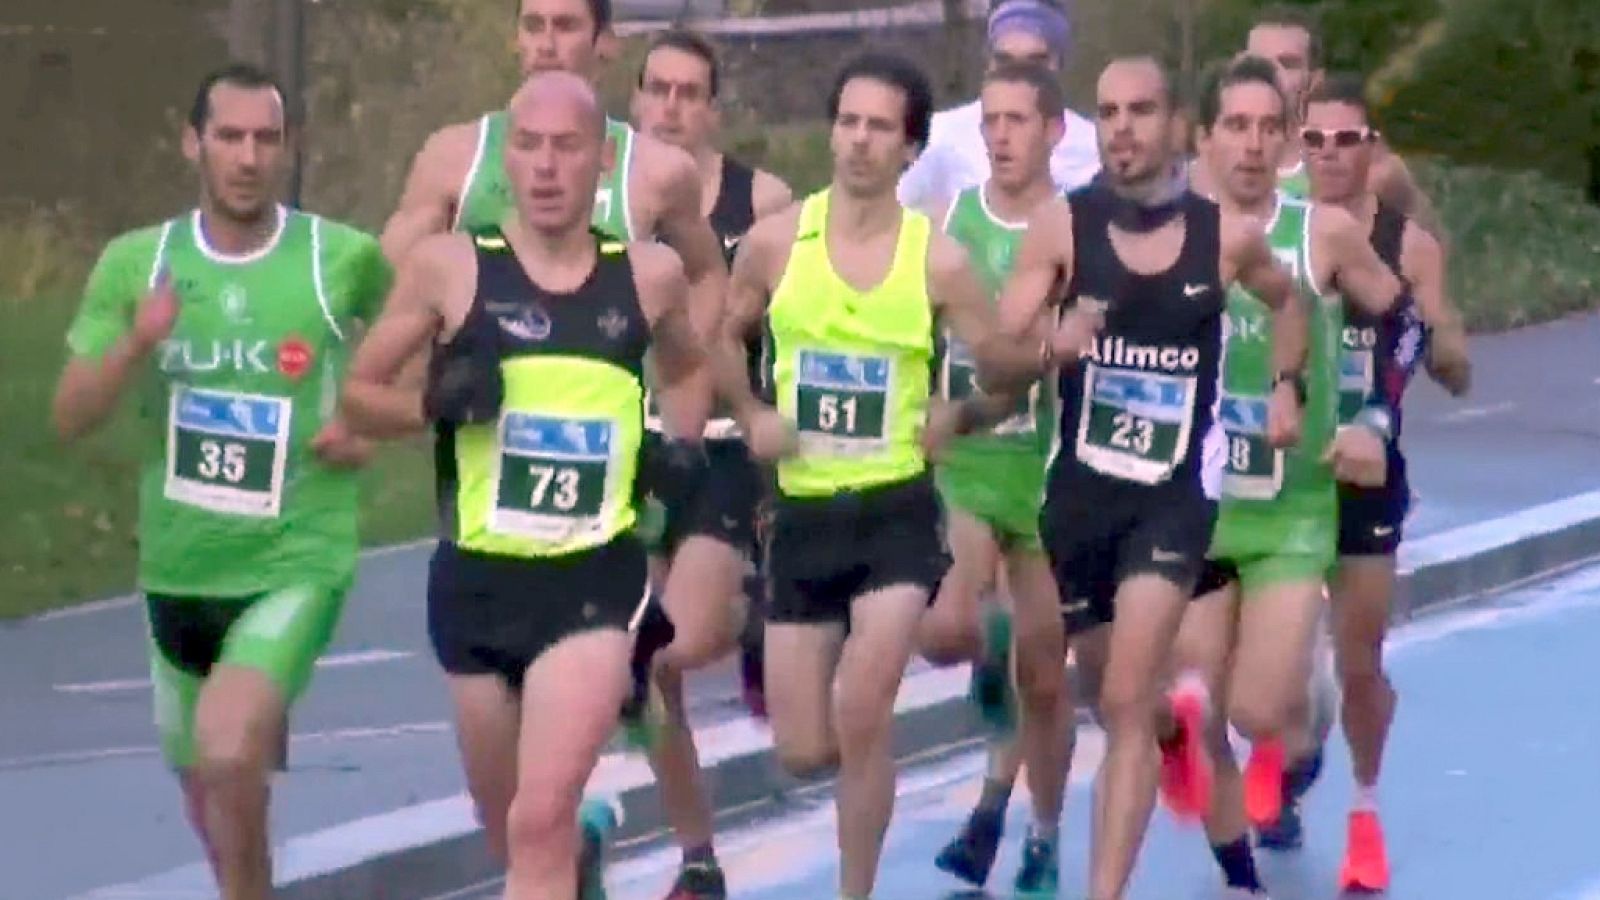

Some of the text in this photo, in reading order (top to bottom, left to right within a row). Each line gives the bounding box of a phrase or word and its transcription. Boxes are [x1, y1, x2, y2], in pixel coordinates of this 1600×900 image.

[818, 394, 857, 433] 51
[1110, 413, 1154, 455] 23
[197, 440, 247, 482] 35
[1231, 437, 1250, 470] 8
[529, 465, 580, 511] 73
